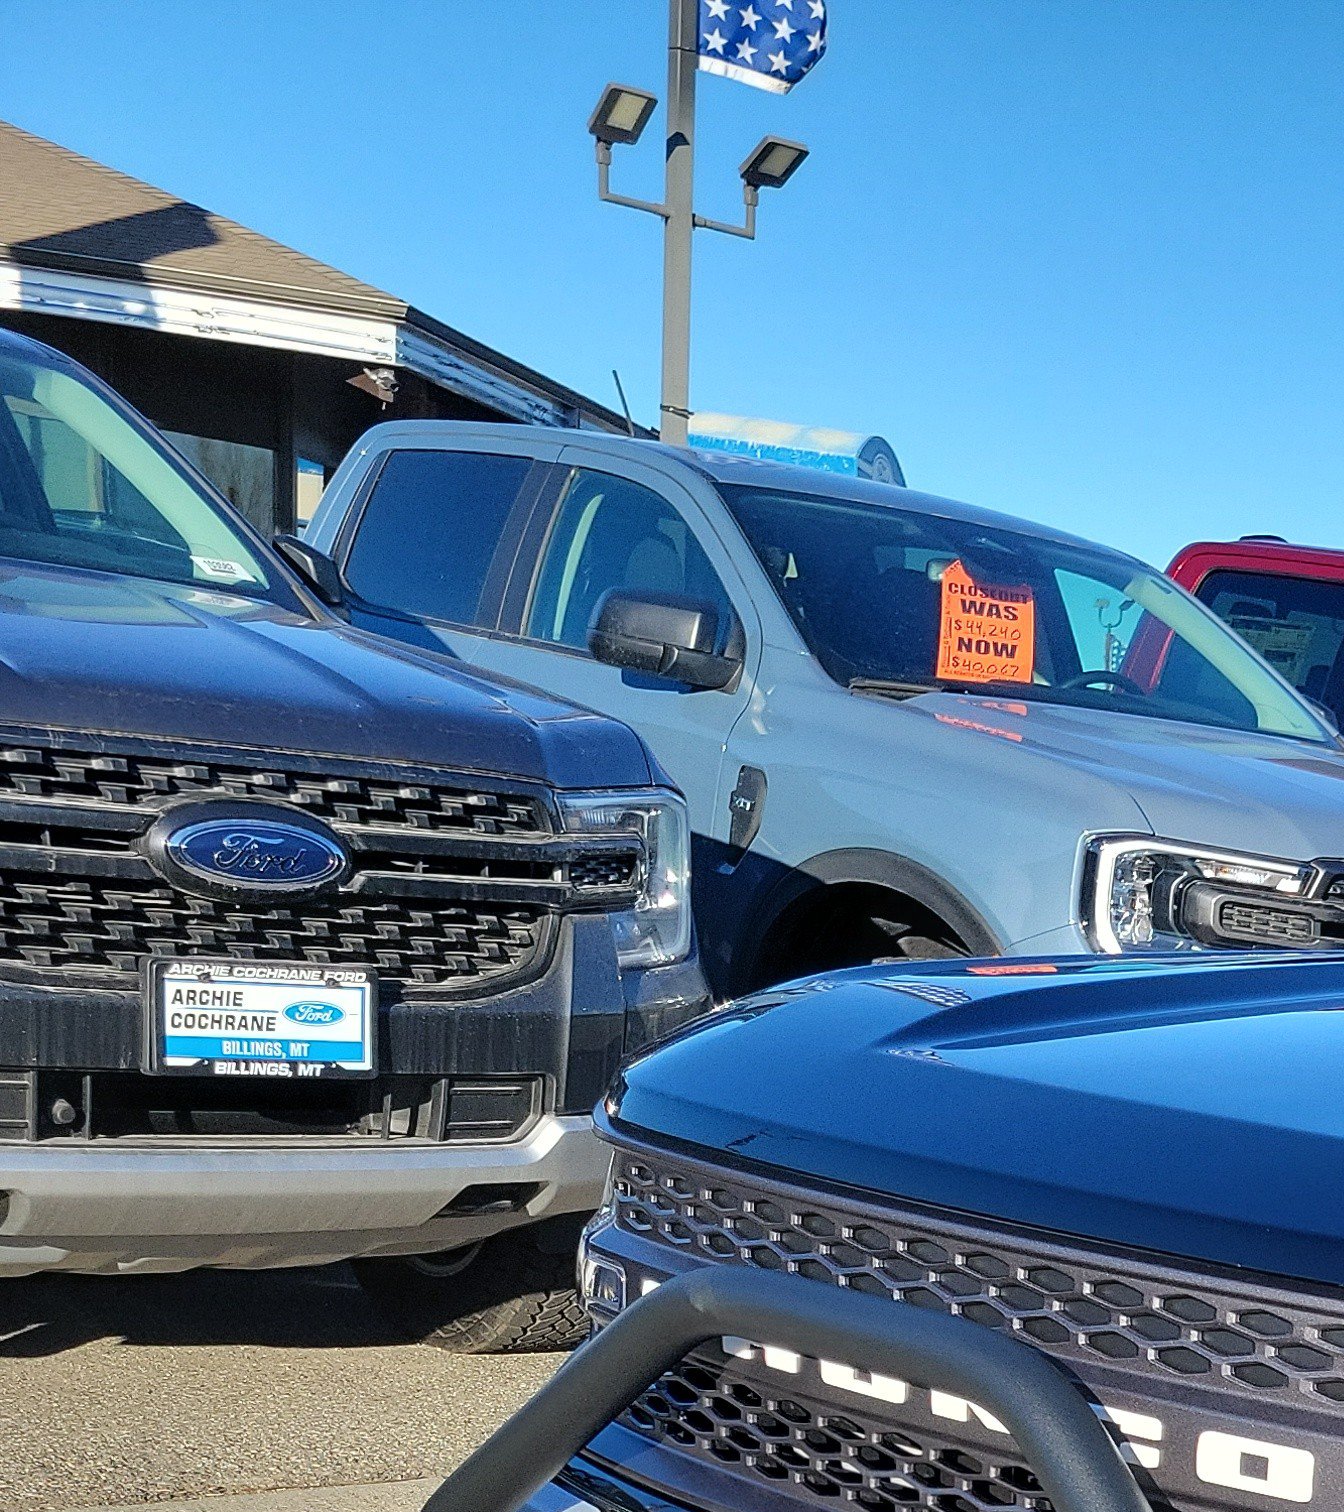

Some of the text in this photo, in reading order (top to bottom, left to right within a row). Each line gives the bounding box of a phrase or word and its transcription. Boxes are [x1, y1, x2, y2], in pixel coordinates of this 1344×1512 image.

[960, 598, 1018, 621] WAS
[957, 636, 1018, 659] NOW
[213, 832, 307, 875] Ford
[168, 963, 367, 984] ARCHIE COCHRANE FORD
[171, 988, 244, 1007] ARCHIE
[170, 1012, 277, 1032] COCHRANE
[294, 1004, 333, 1023] Ford
[222, 1040, 310, 1059] BILLINGS, MT
[214, 1063, 325, 1078] BILLINGS, MT
